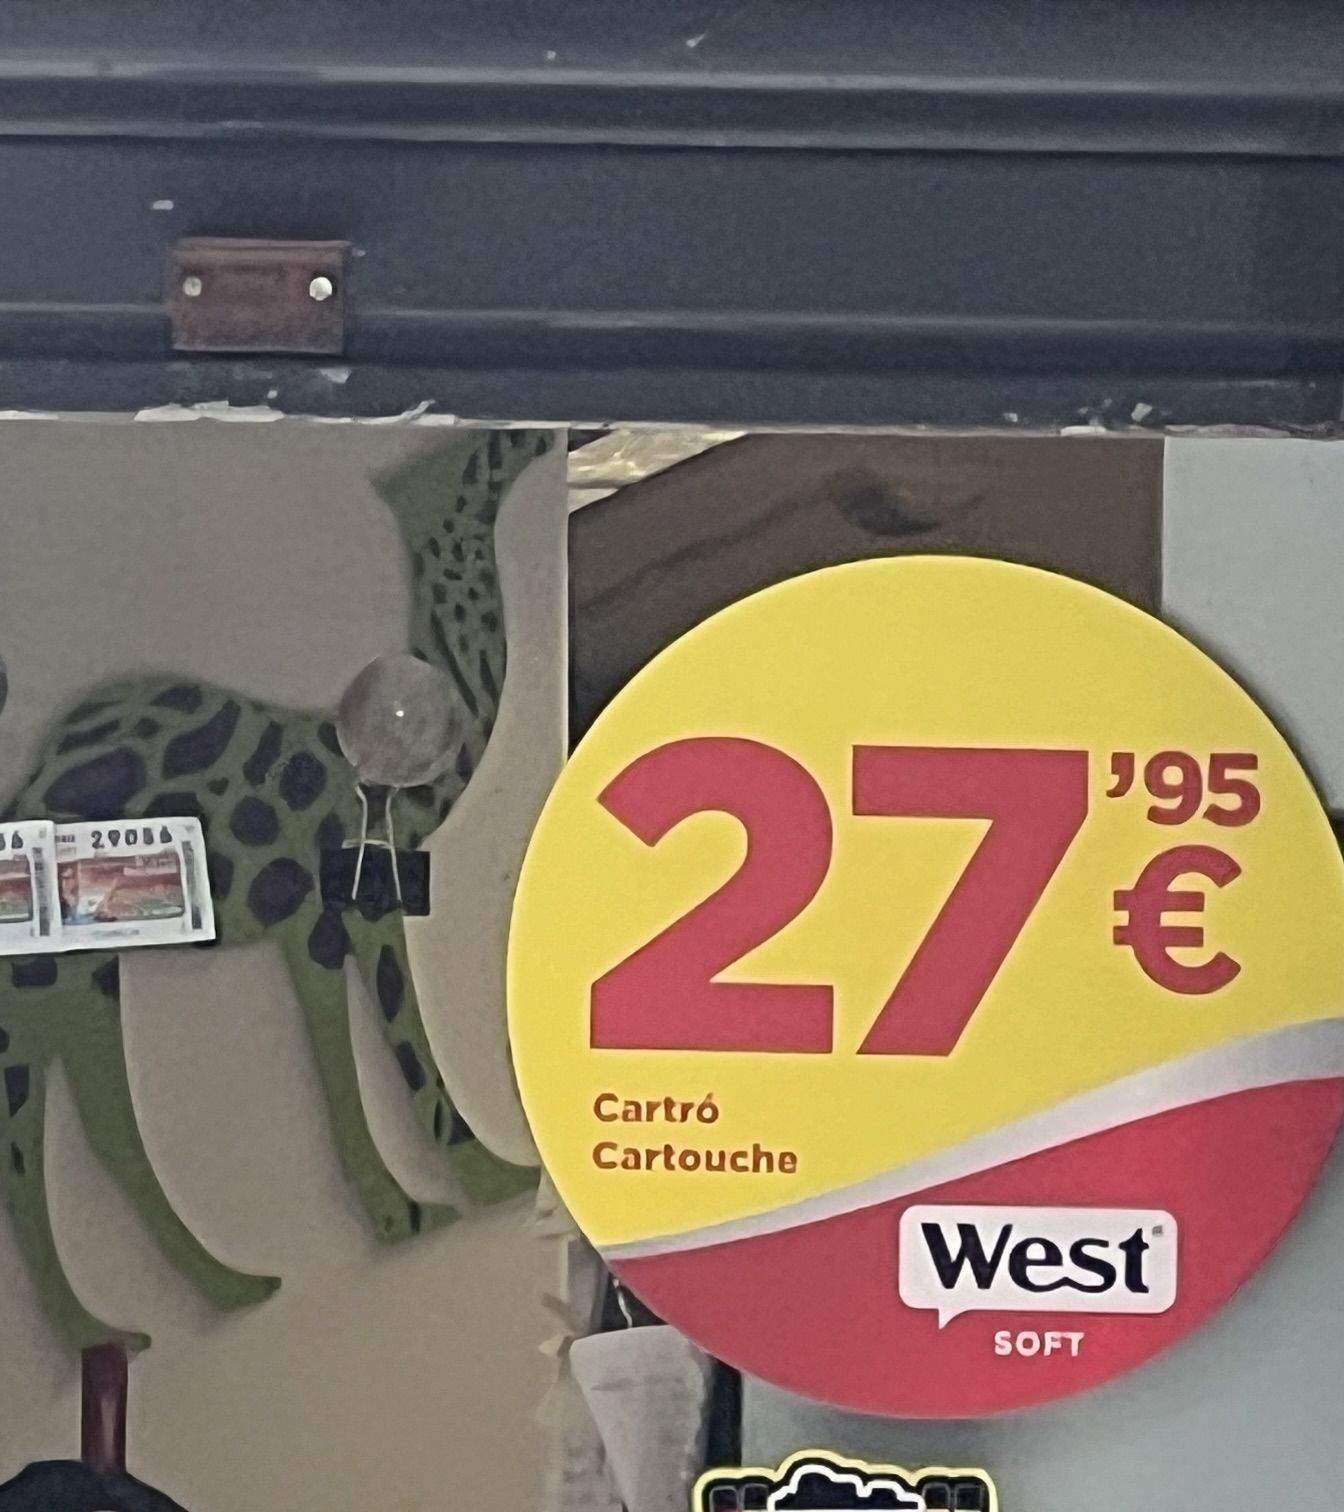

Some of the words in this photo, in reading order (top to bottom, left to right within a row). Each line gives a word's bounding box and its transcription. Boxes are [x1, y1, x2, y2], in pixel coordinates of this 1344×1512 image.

[590, 737, 1089, 1056] 27
[1114, 844, 1242, 996] €
[593, 1092, 720, 1125] Cartró
[592, 1142, 799, 1176] Cartouche
[920, 1221, 1152, 1295] West
[993, 1331, 1086, 1359] SOFT
